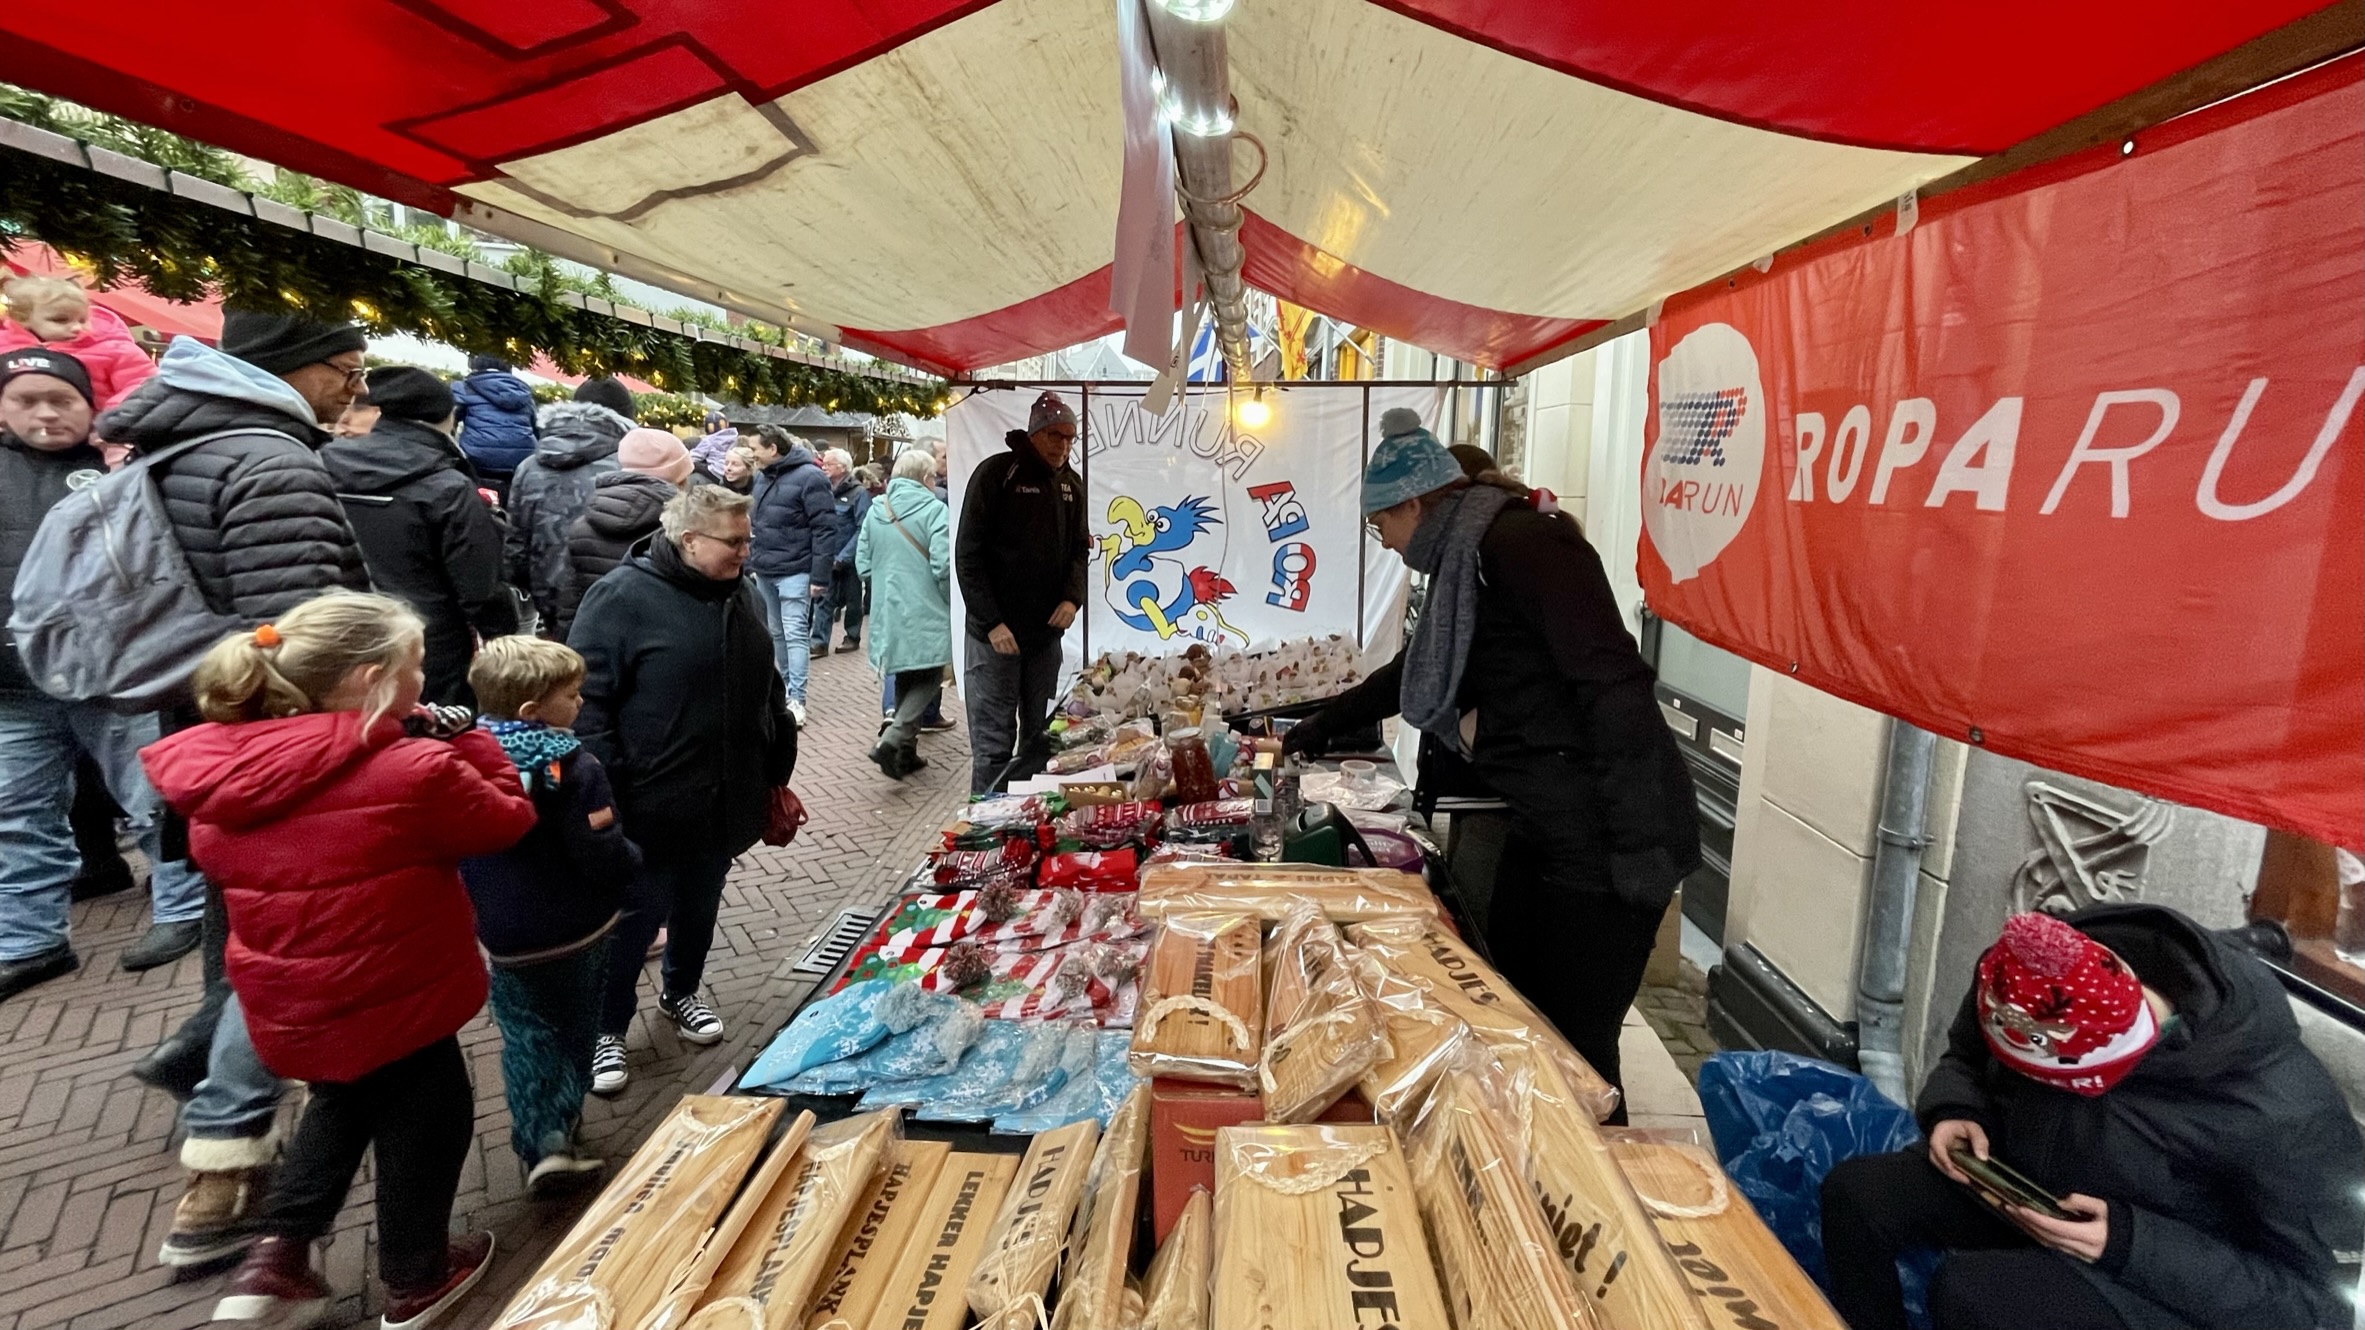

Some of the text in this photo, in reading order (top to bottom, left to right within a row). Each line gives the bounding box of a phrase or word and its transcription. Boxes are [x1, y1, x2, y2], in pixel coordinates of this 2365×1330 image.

[937, 1171, 985, 1247] LEKKER
[570, 1227, 626, 1284] maa
[1336, 1169, 1402, 1330] HADJE
